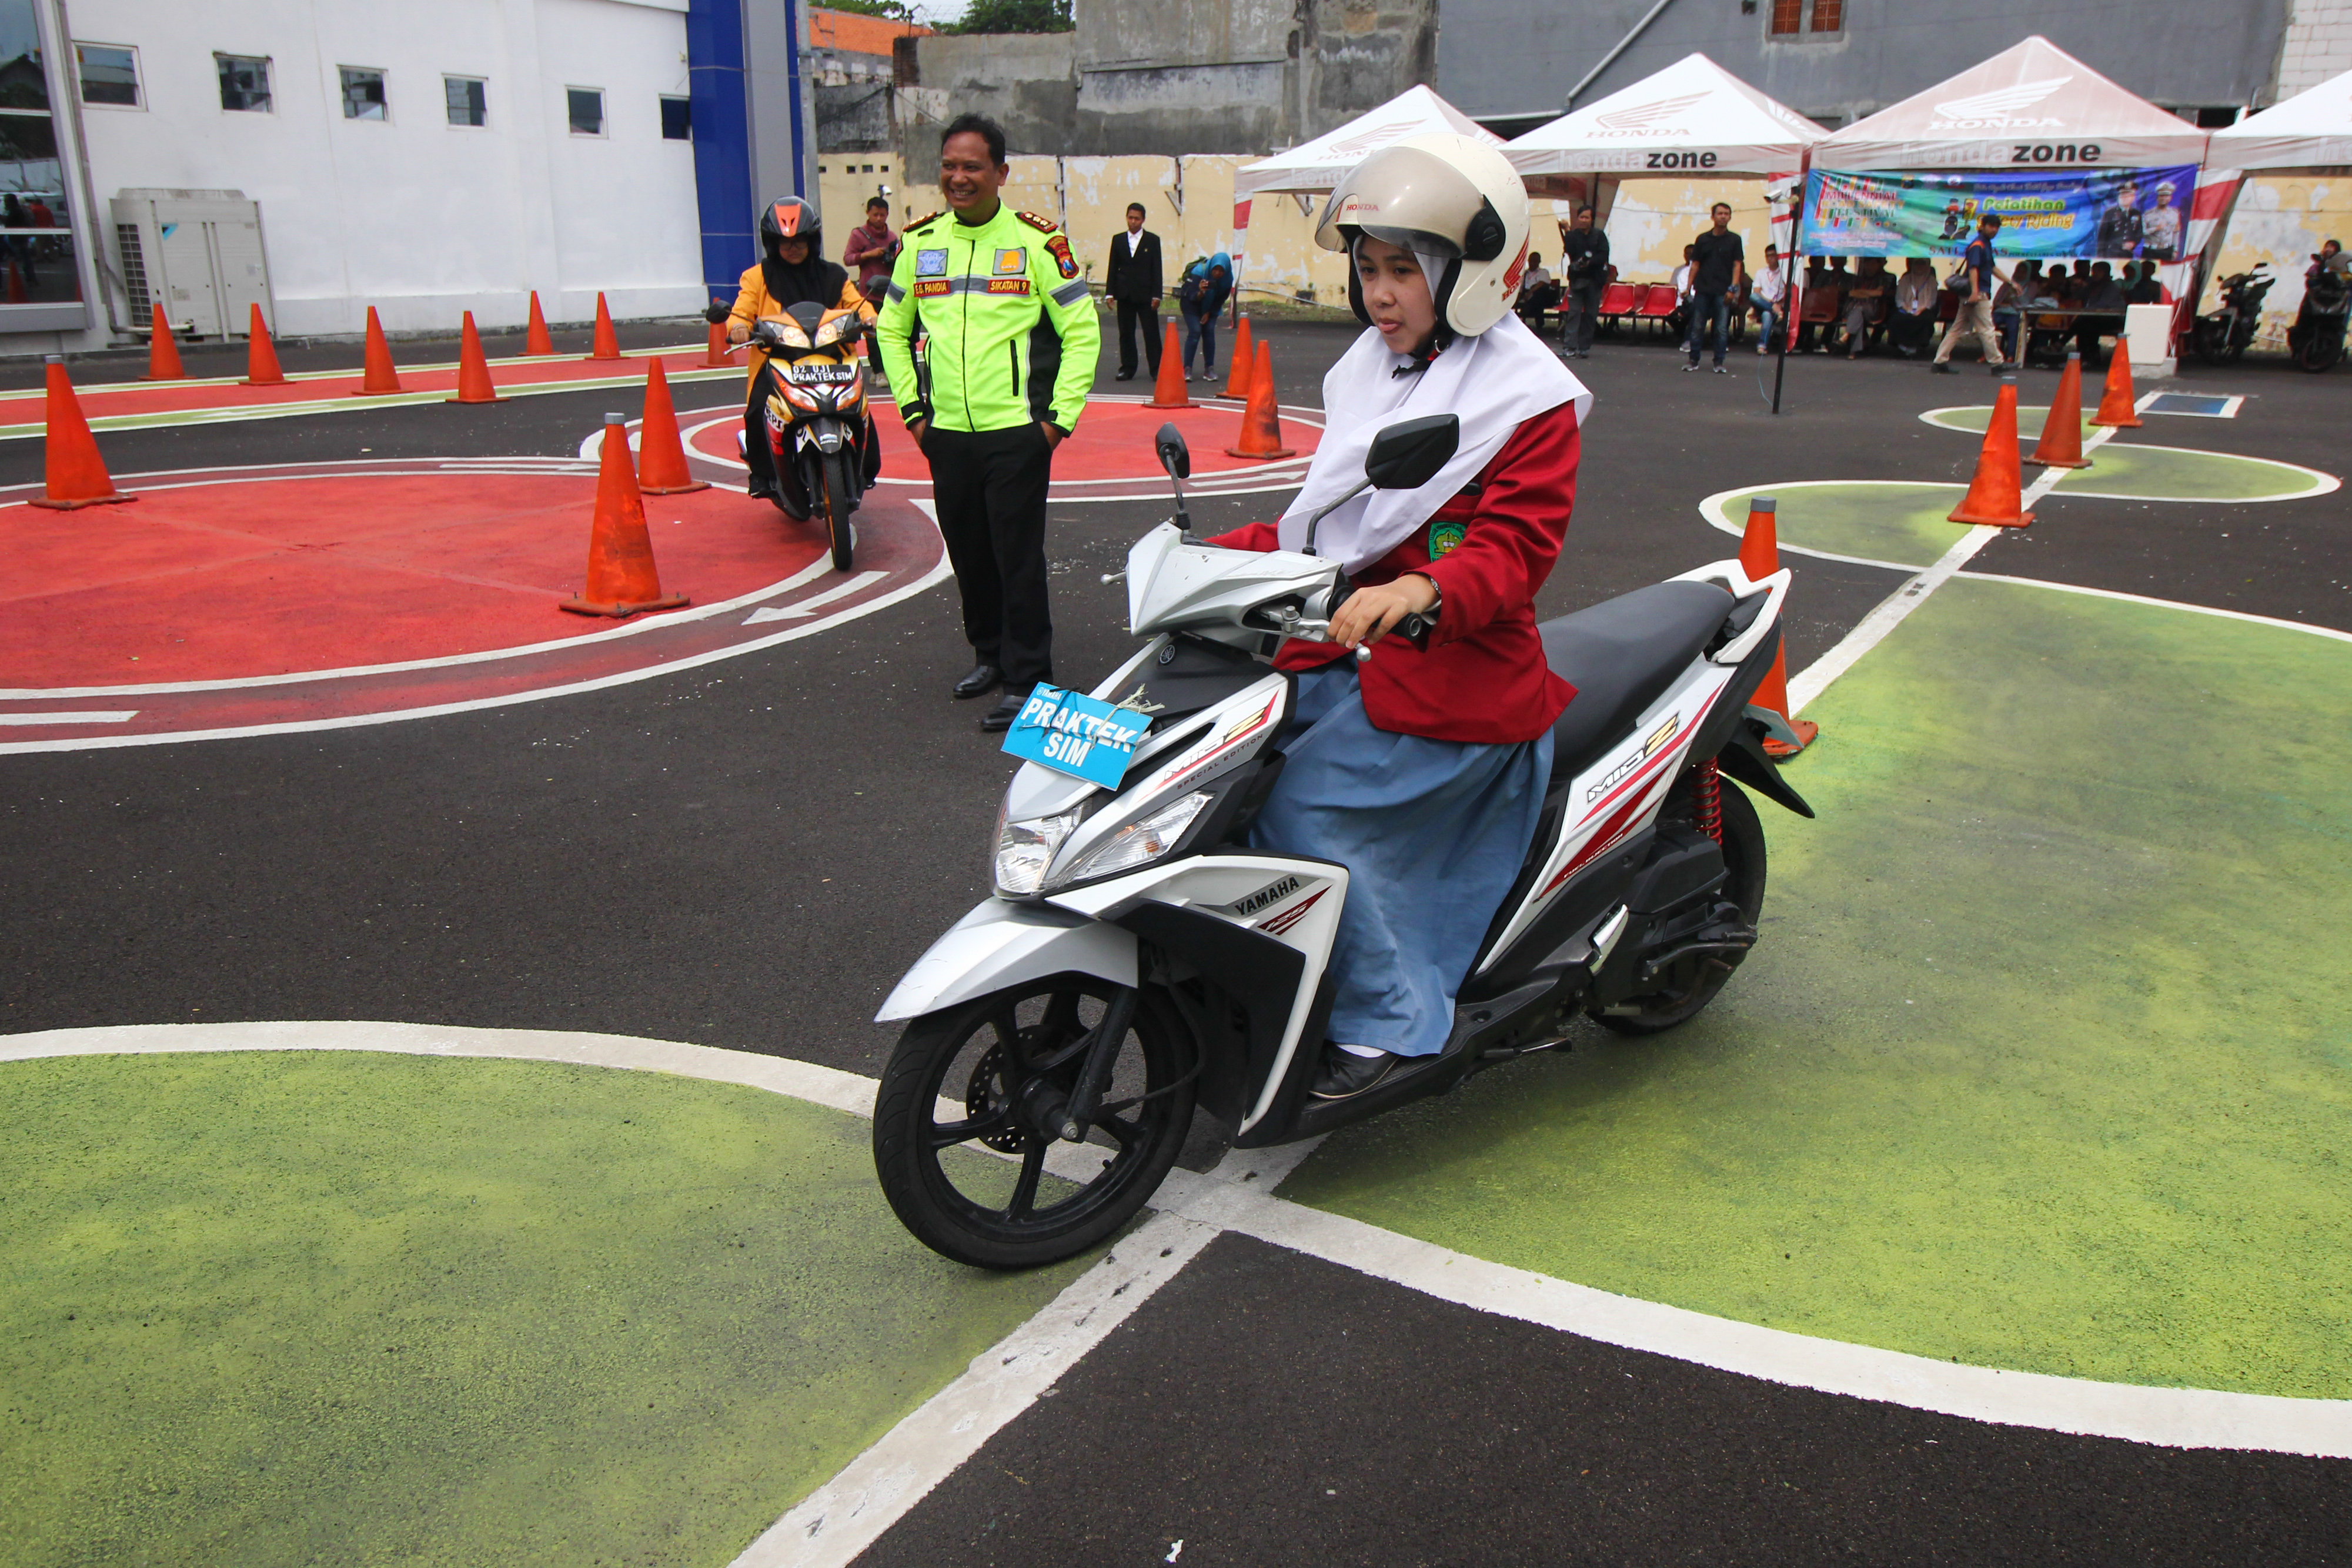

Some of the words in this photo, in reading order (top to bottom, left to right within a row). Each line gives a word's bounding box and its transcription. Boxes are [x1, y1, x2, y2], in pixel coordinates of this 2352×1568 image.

[1927, 118, 2066, 131] HONDA
[1585, 128, 1692, 138] HONDA
[1826, 190, 1897, 200] MILLENNIAL
[1346, 203, 1380, 212] HONDA
[1929, 245, 2009, 257] SATLAS
[925, 282, 947, 293] PANDIA
[990, 280, 1020, 292] SIKATAN
[1022, 281, 1027, 292] 9
[812, 365, 830, 373] UJI
[793, 372, 836, 382] PRAKTEK
[836, 372, 853, 380] SIM
[1041, 687, 1063, 701] YAMAHA
[1020, 697, 1138, 754] PRAKTEK
[1043, 731, 1092, 767] SIM
[1177, 762, 1220, 790] SPECIAL
[1223, 733, 1264, 761] EDITION
[1563, 862, 1585, 878] FUEL
[1585, 833, 1623, 863] INJECTION
[1235, 876, 1300, 915] YAMAHA
